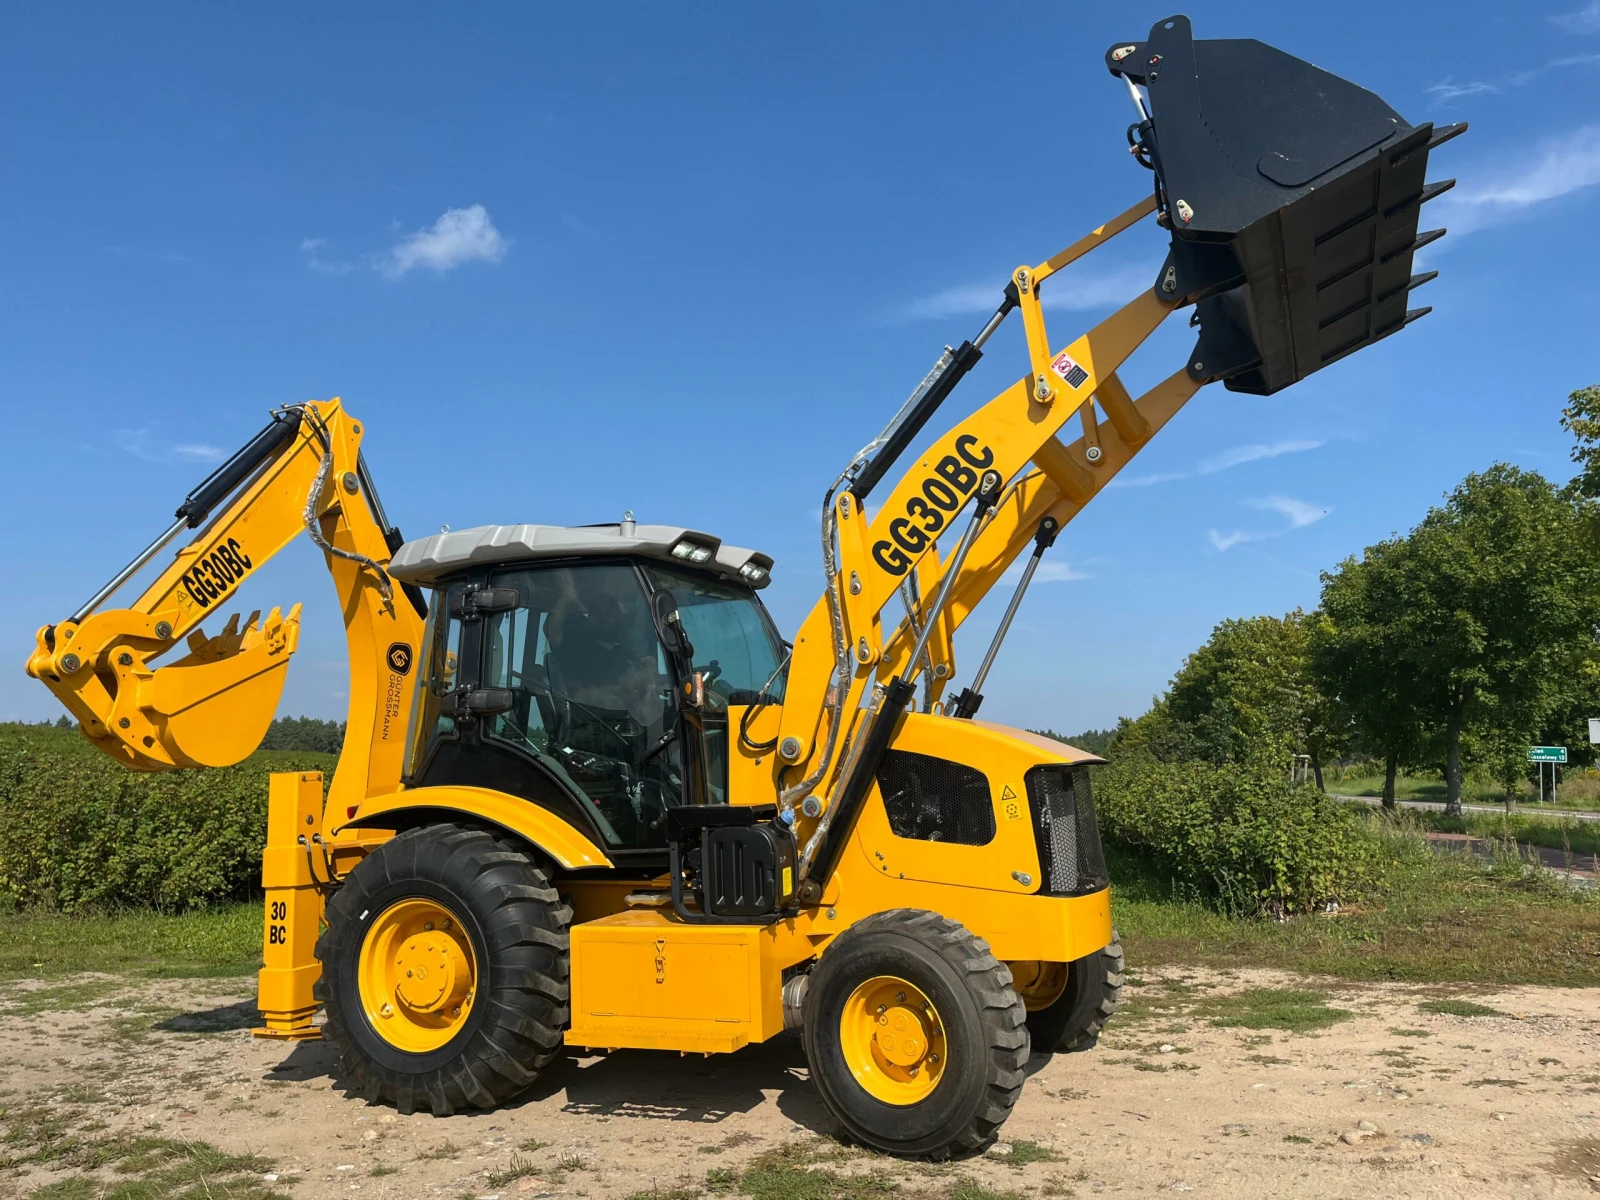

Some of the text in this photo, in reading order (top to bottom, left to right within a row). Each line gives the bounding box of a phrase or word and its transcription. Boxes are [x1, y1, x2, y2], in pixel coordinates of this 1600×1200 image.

[871, 434, 994, 576] GG30BC
[181, 538, 252, 608] GG30BC
[382, 674, 396, 741] GROSSMANN
[392, 675, 404, 718] GÜNTER
[270, 925, 286, 945] BC
[271, 901, 286, 921] 30
